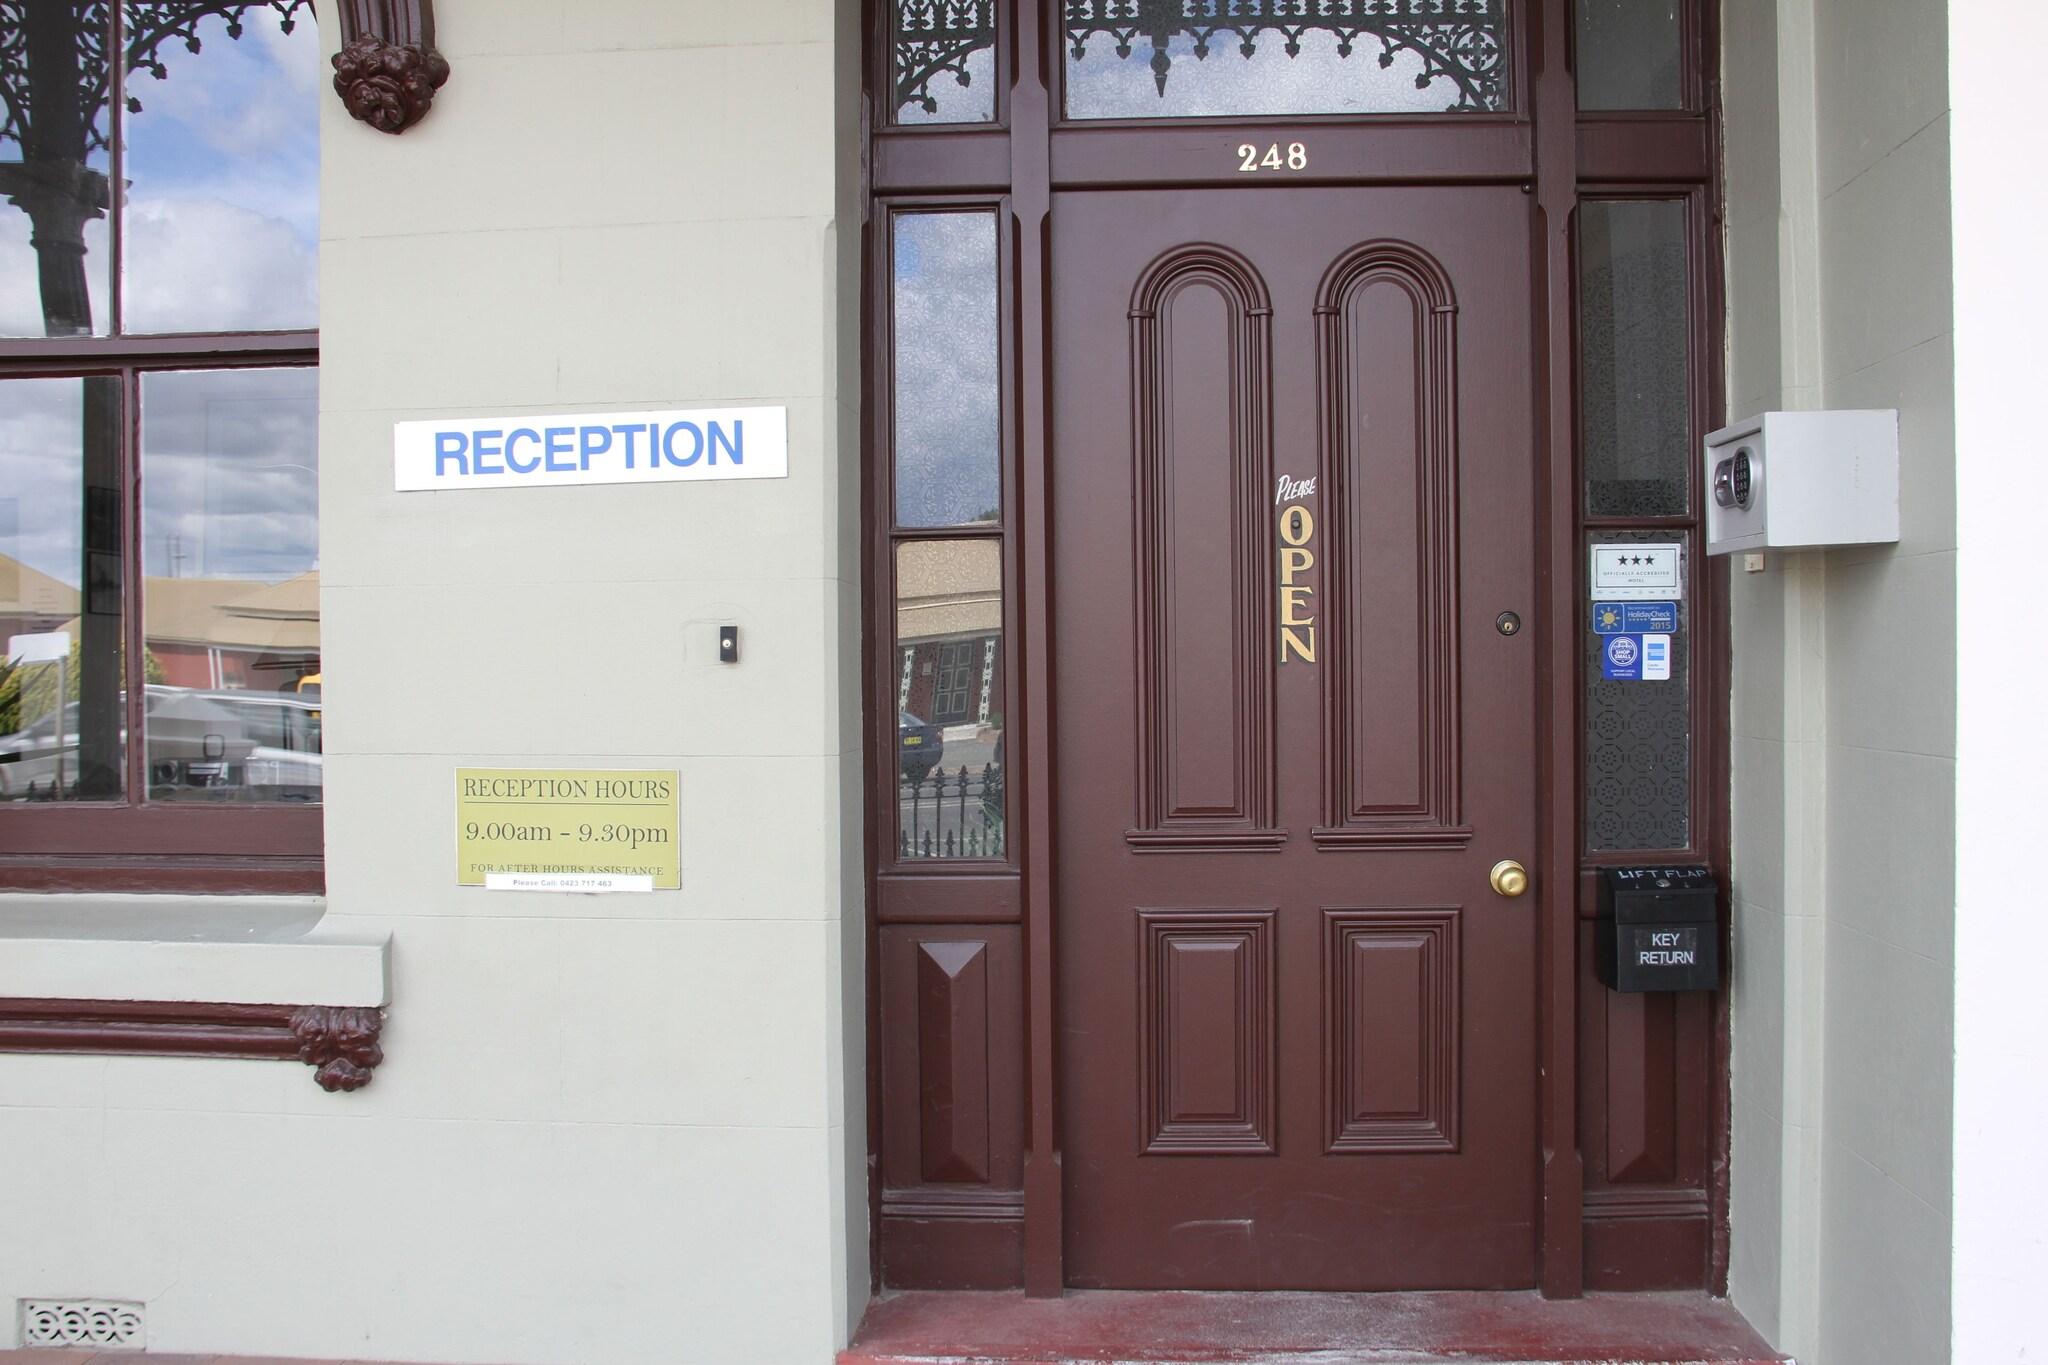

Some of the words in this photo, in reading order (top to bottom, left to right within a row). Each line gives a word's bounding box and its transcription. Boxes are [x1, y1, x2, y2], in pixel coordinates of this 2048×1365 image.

[1237, 142, 1307, 172] 248
[434, 420, 744, 476] RECEPTION
[1279, 505, 1317, 663] OPEN
[1627, 610, 1671, 618] HolidayCheck
[1650, 622, 1671, 630] 2015
[464, 778, 587, 798] RECEPTION
[596, 780, 670, 799] HOURS
[466, 822, 552, 841] 9.00am
[578, 823, 669, 850] 9.30pm
[470, 863, 494, 873] FOR
[498, 864, 538, 873] AFTER
[543, 865, 585, 874] HOURS
[589, 865, 664, 875] ASSISTANCE
[1618, 869, 1659, 879] LIFT
[1664, 869, 1707, 879] FLAP
[513, 879, 539, 887] Please
[1651, 933, 1681, 946] KEY
[1639, 951, 1694, 965] RETURN
